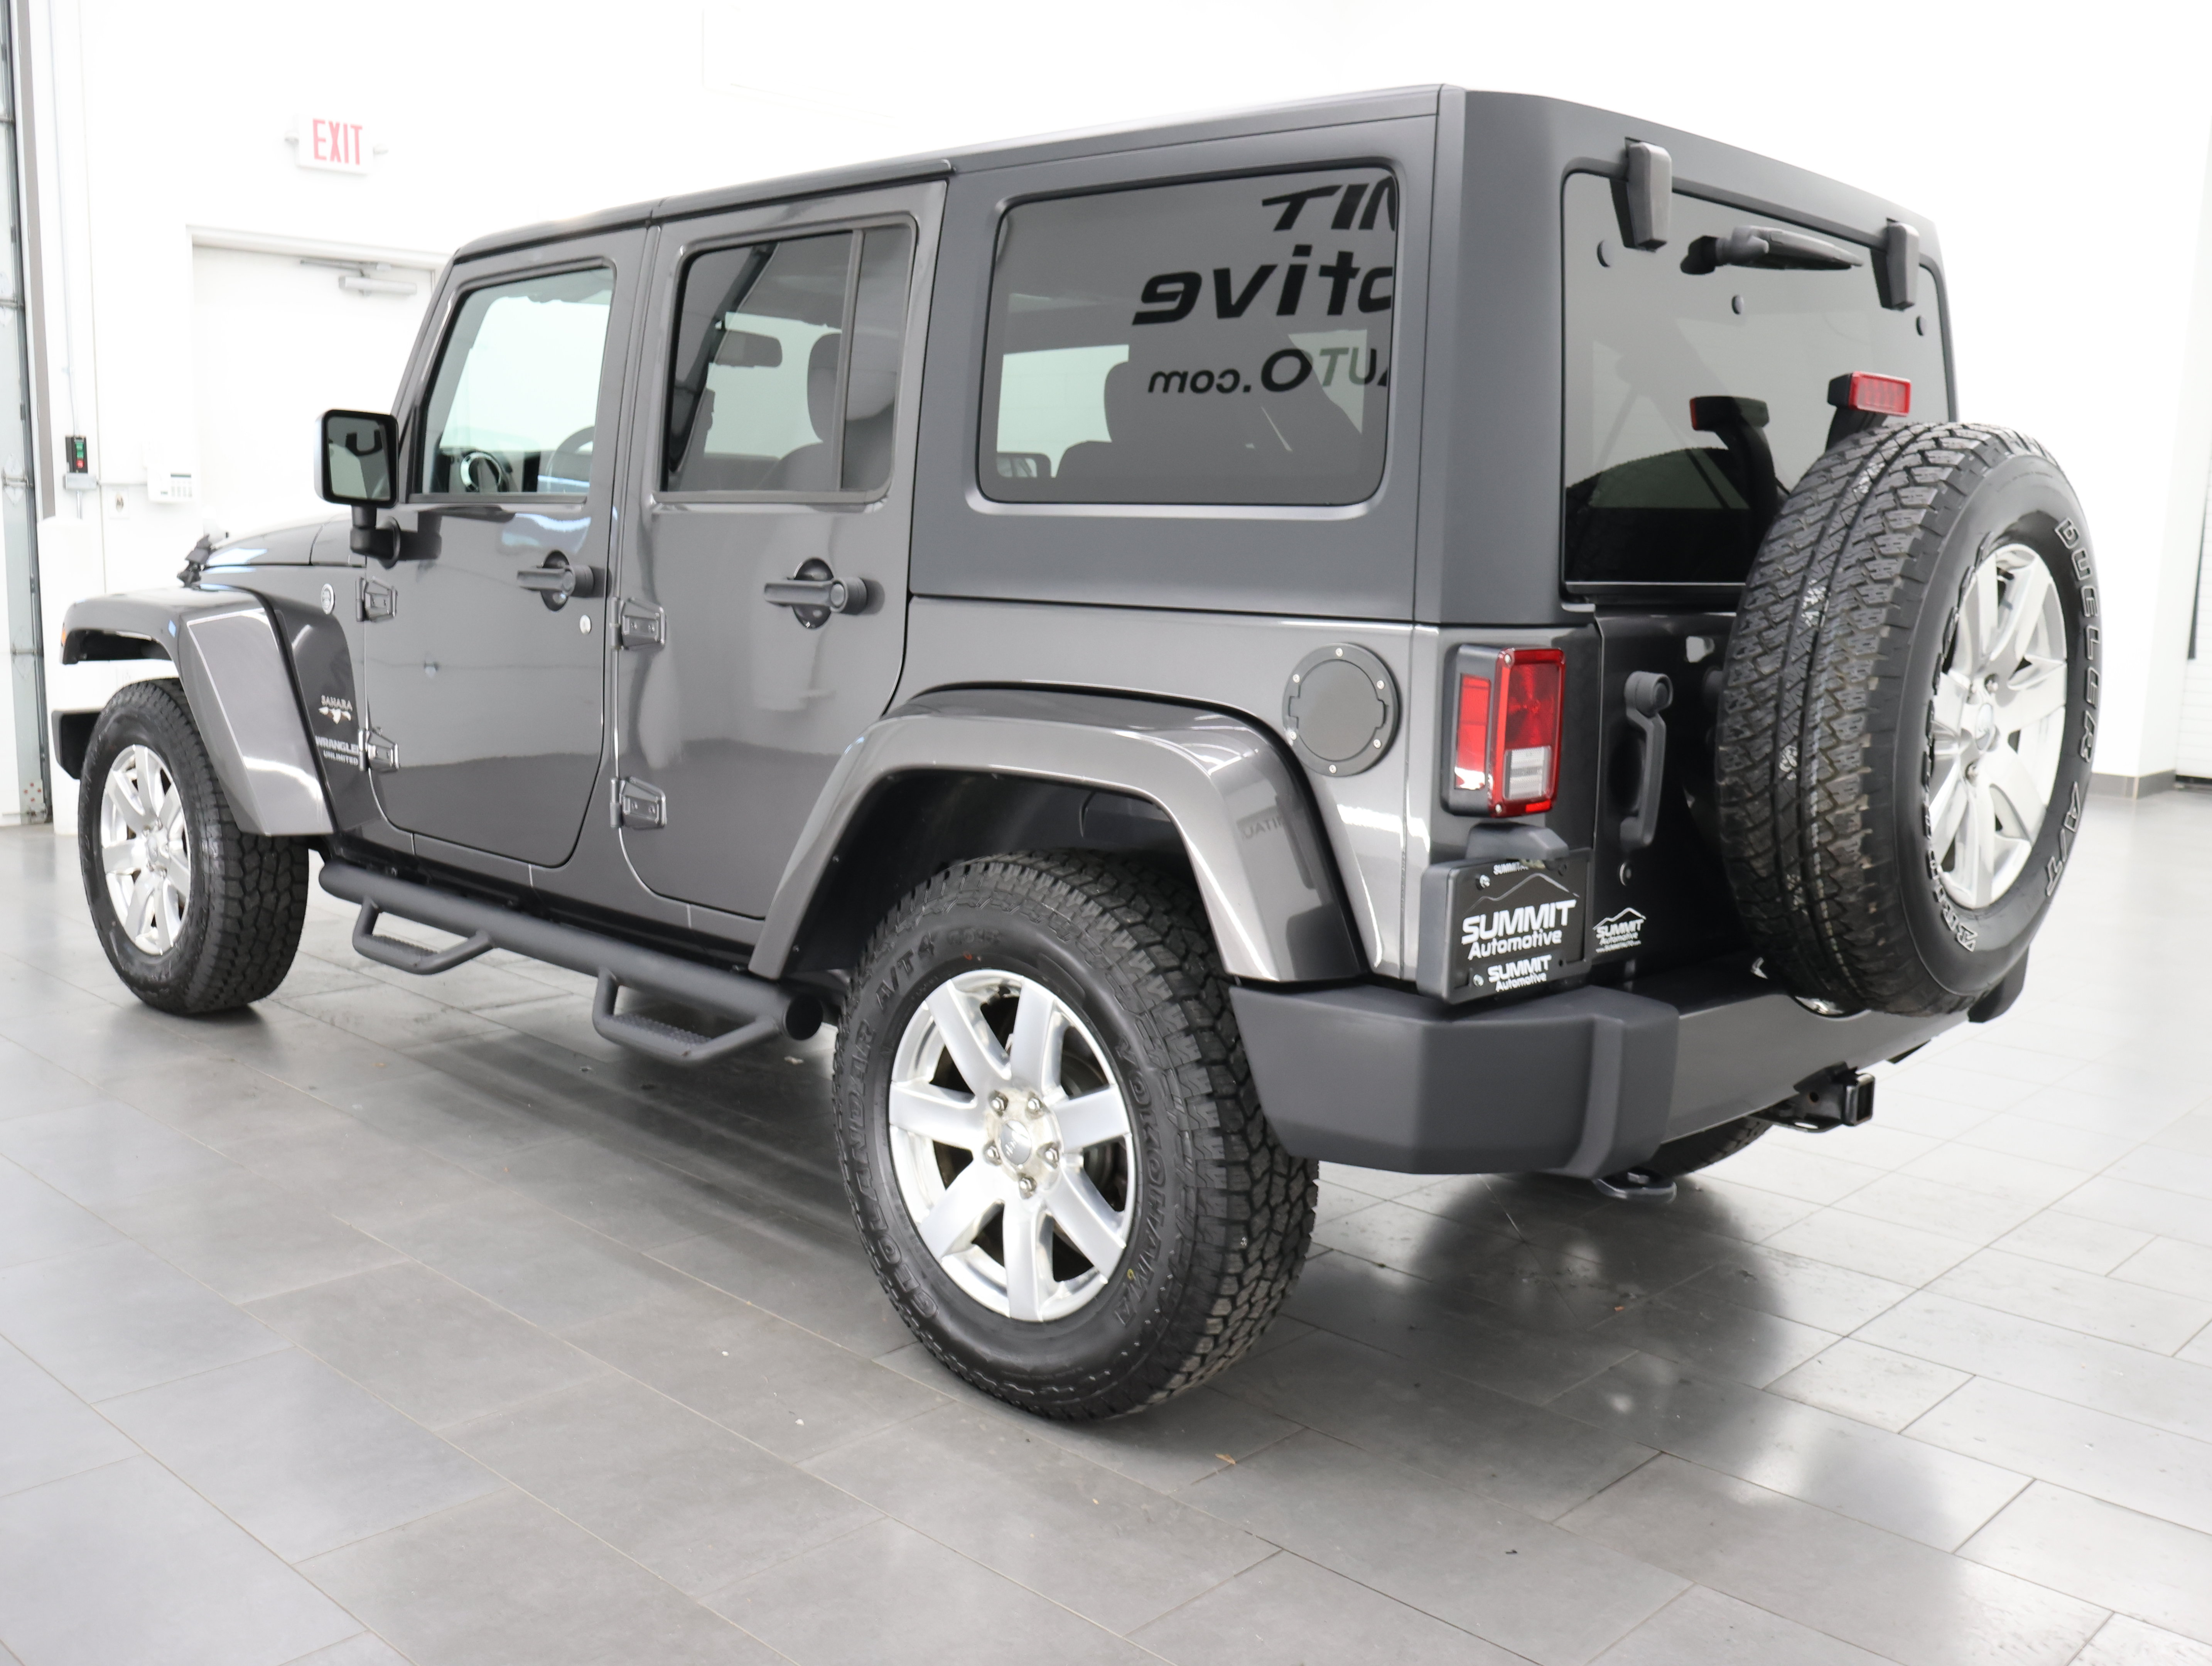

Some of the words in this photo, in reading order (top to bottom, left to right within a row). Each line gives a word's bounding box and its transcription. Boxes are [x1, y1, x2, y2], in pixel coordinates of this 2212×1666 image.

[313, 118, 363, 165] EXIT
[2054, 517, 2100, 762] DUELER
[321, 695, 353, 712] SAHARA
[323, 750, 358, 766] UNLIMITED
[1461, 899, 1577, 944] SUMMIT
[1596, 919, 1644, 939] SUMMIT
[1468, 929, 1562, 960] Automotive
[1599, 932, 1638, 946] Automotive
[1487, 955, 1552, 983] SUMMIT
[1495, 972, 1547, 992] Automotive
